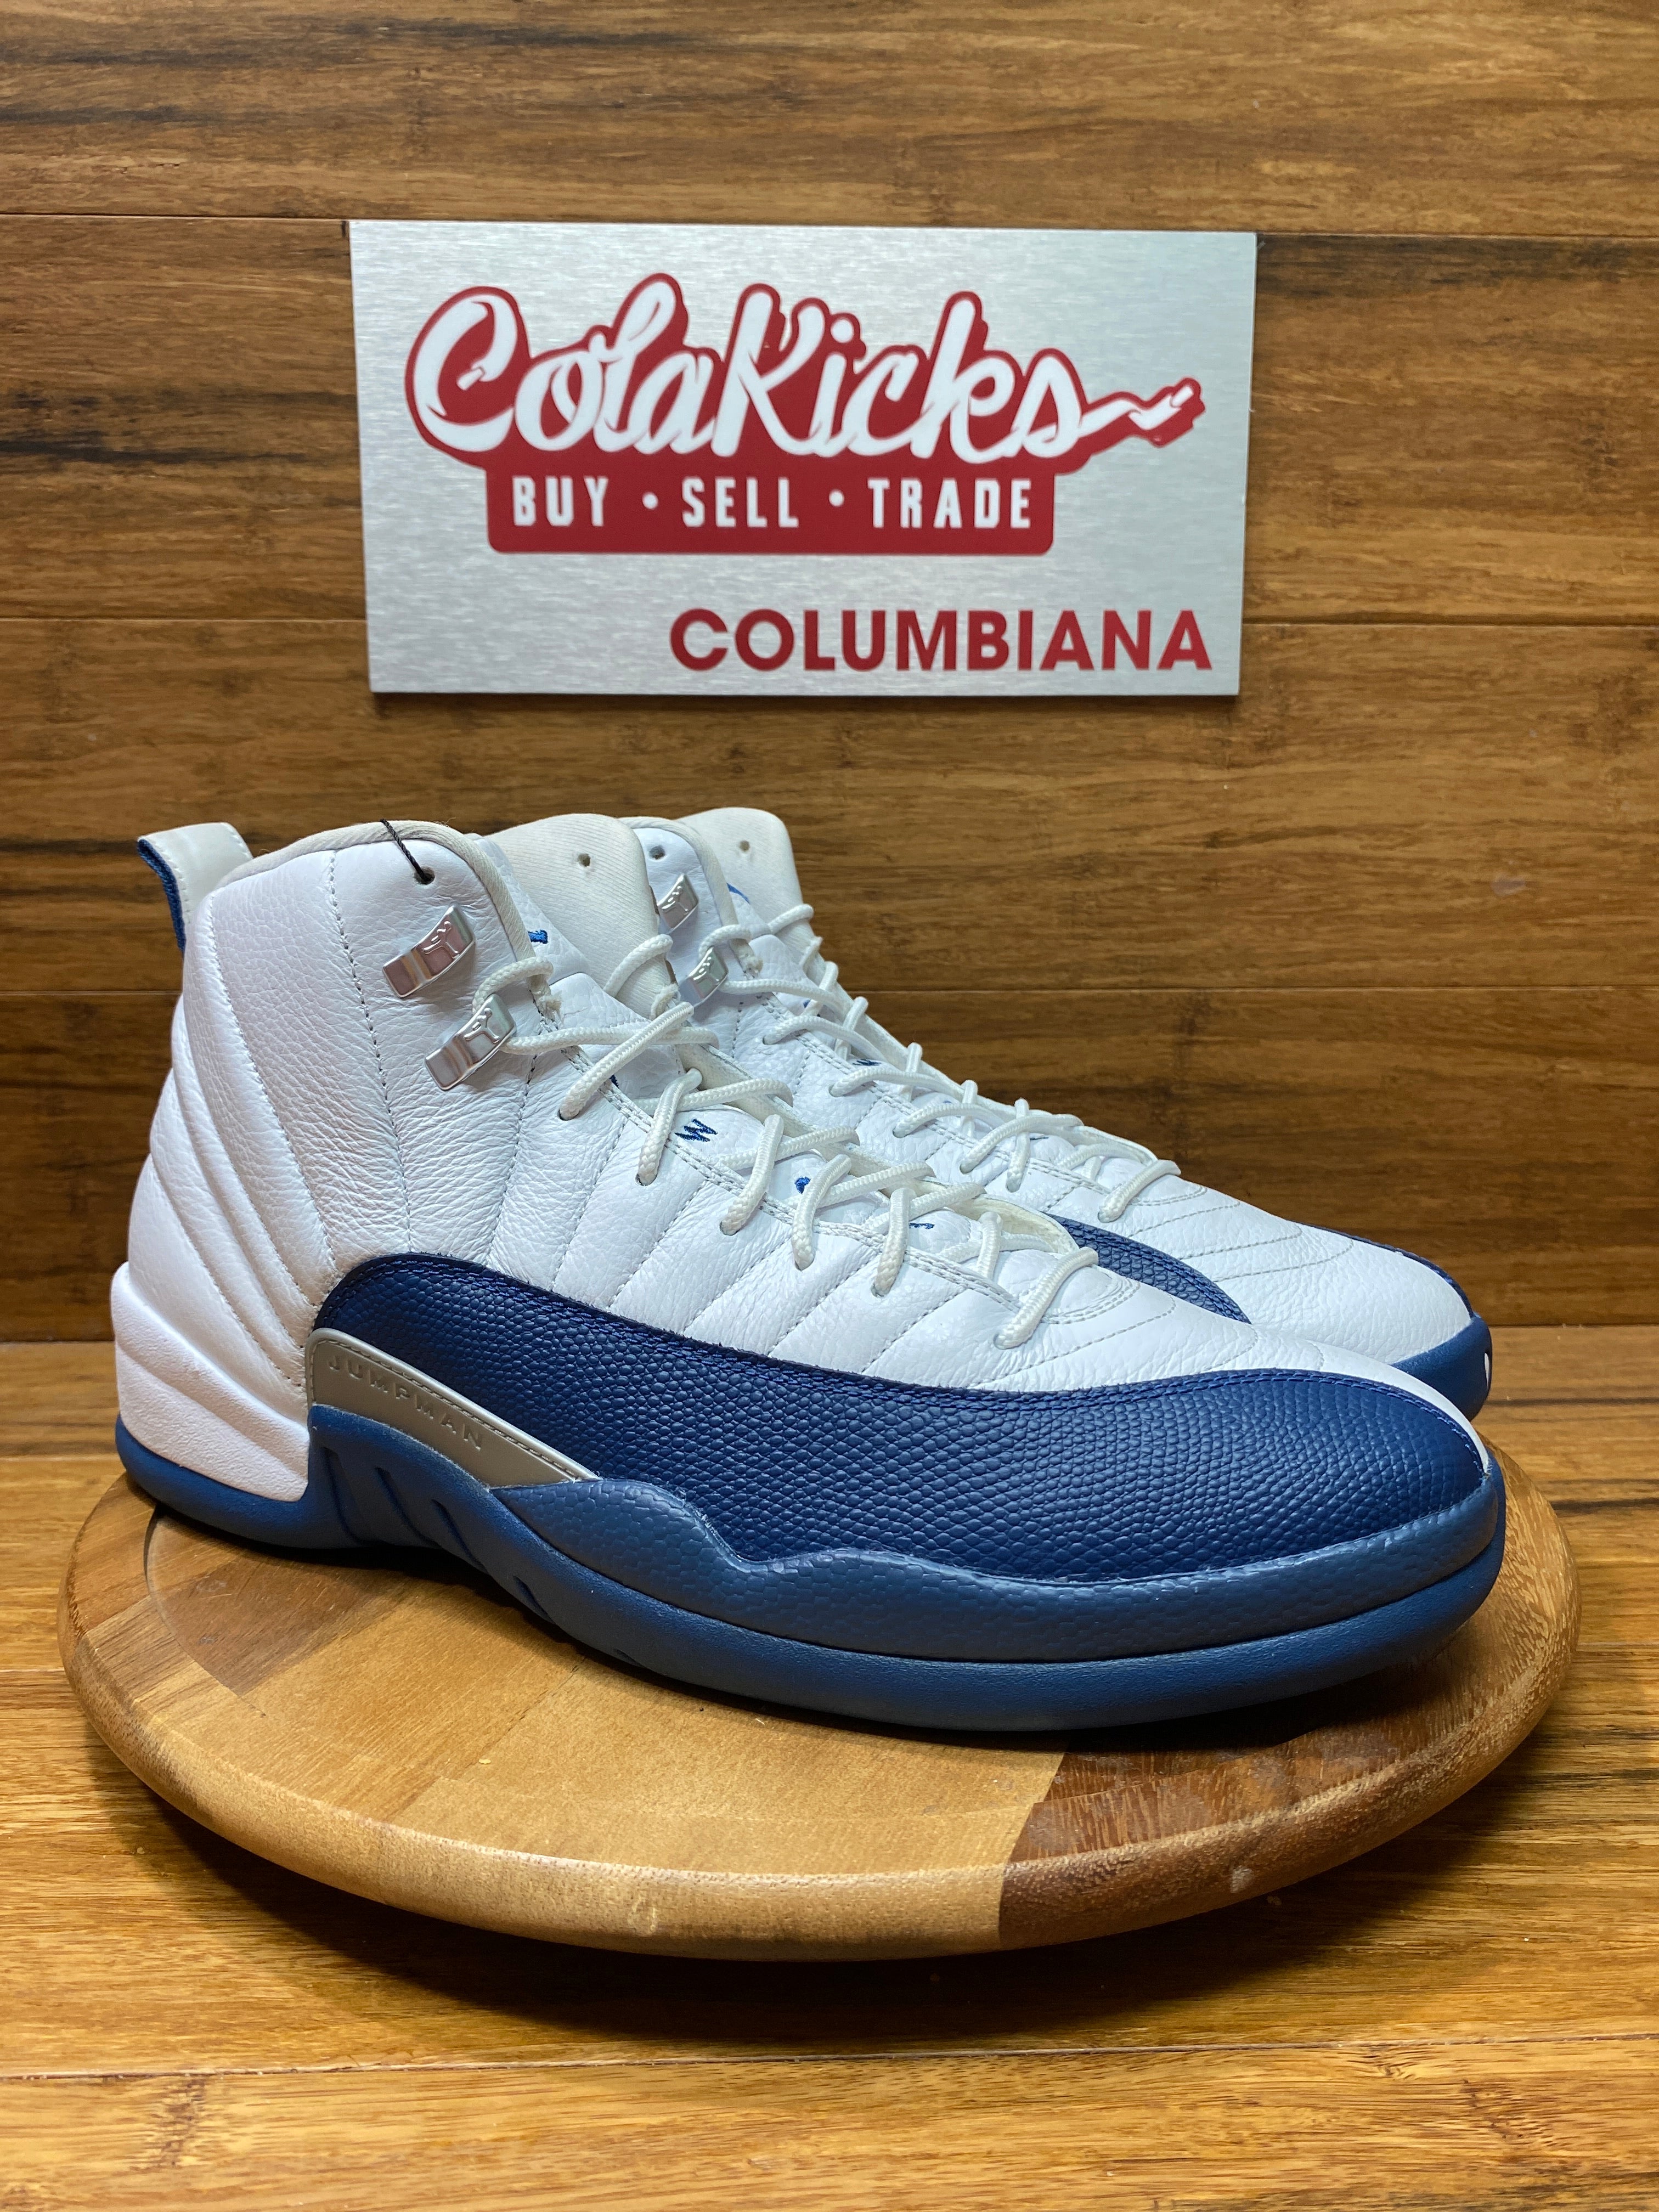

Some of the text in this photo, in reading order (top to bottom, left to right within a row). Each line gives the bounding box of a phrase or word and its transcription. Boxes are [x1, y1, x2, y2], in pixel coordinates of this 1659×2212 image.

[412, 280, 1194, 464] ColaKicks
[512, 476, 1031, 529] BUY SELL TRADE
[670, 608, 1212, 671] COLUMBIANA
[329, 1353, 482, 1451] JUMPMAN
